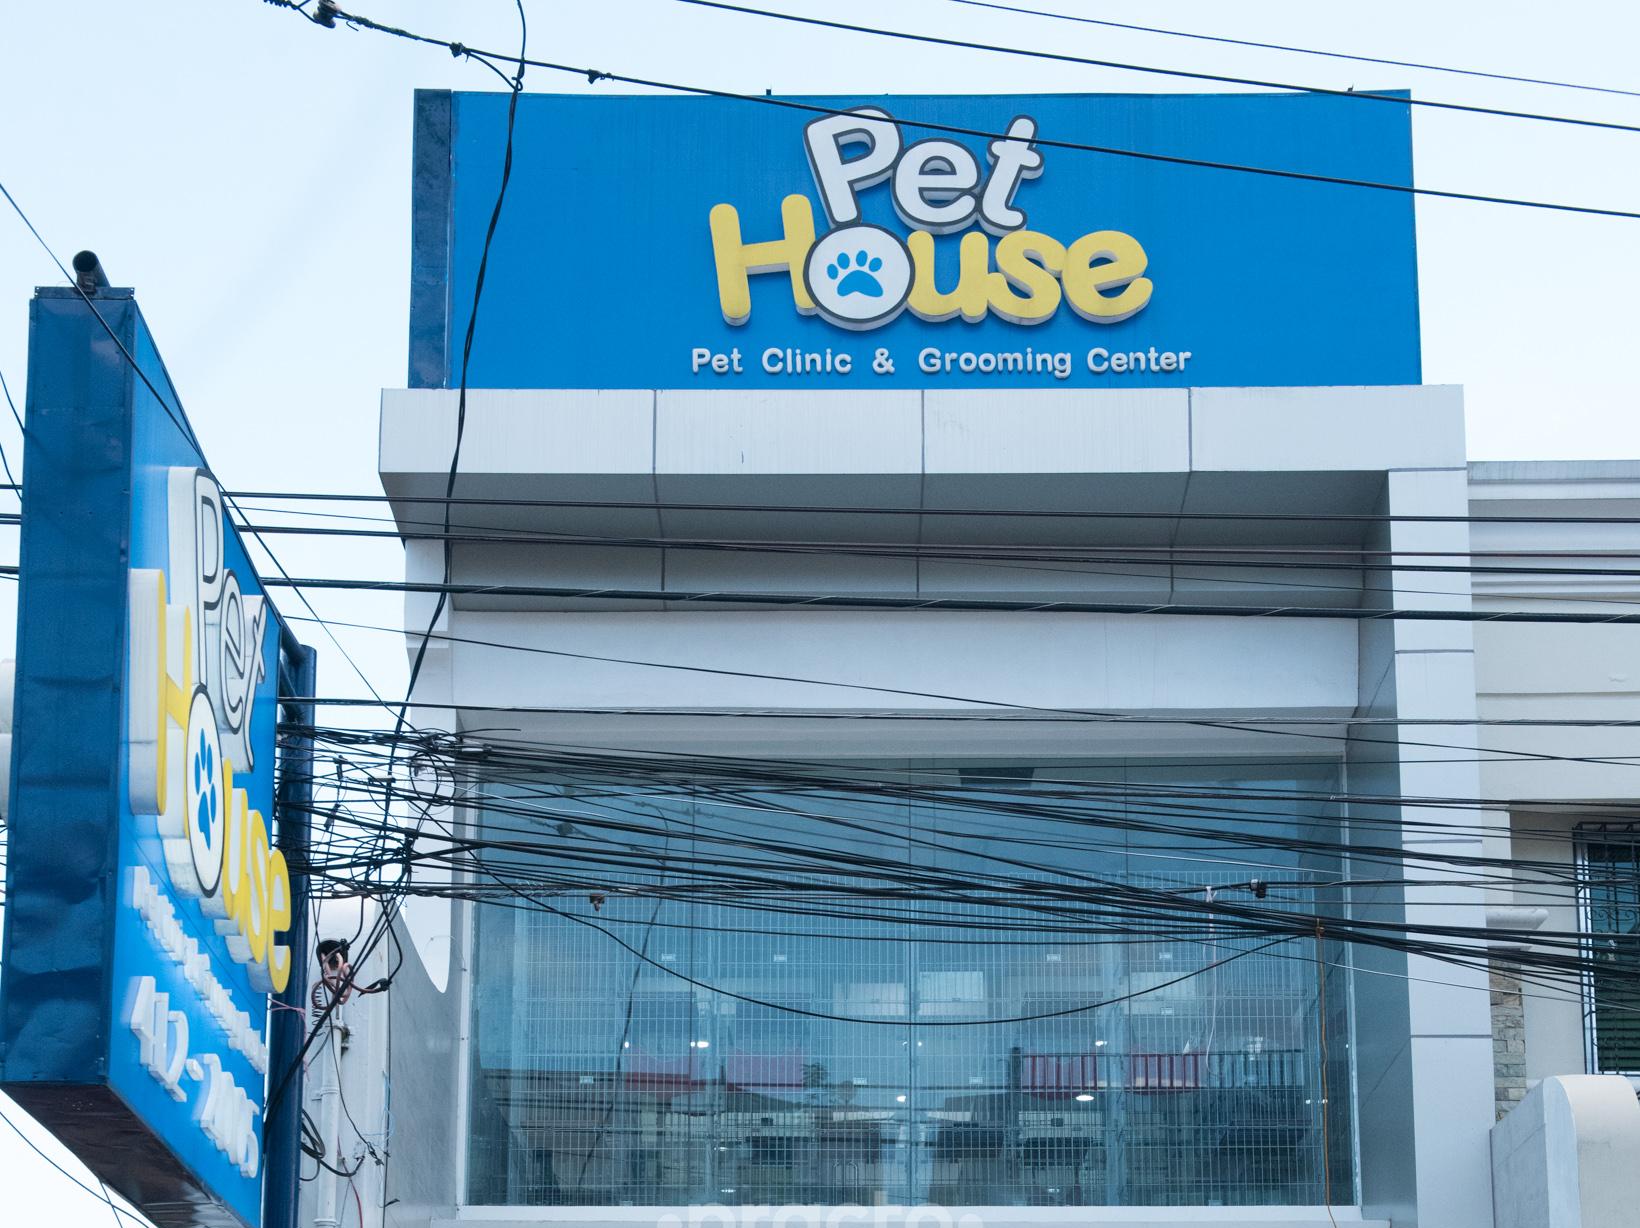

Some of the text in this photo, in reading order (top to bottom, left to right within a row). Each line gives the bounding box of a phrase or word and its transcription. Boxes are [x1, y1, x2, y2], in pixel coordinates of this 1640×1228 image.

[803, 106, 1044, 237] Pet
[691, 346, 1192, 379] Pet Clinic & Grooming Center
